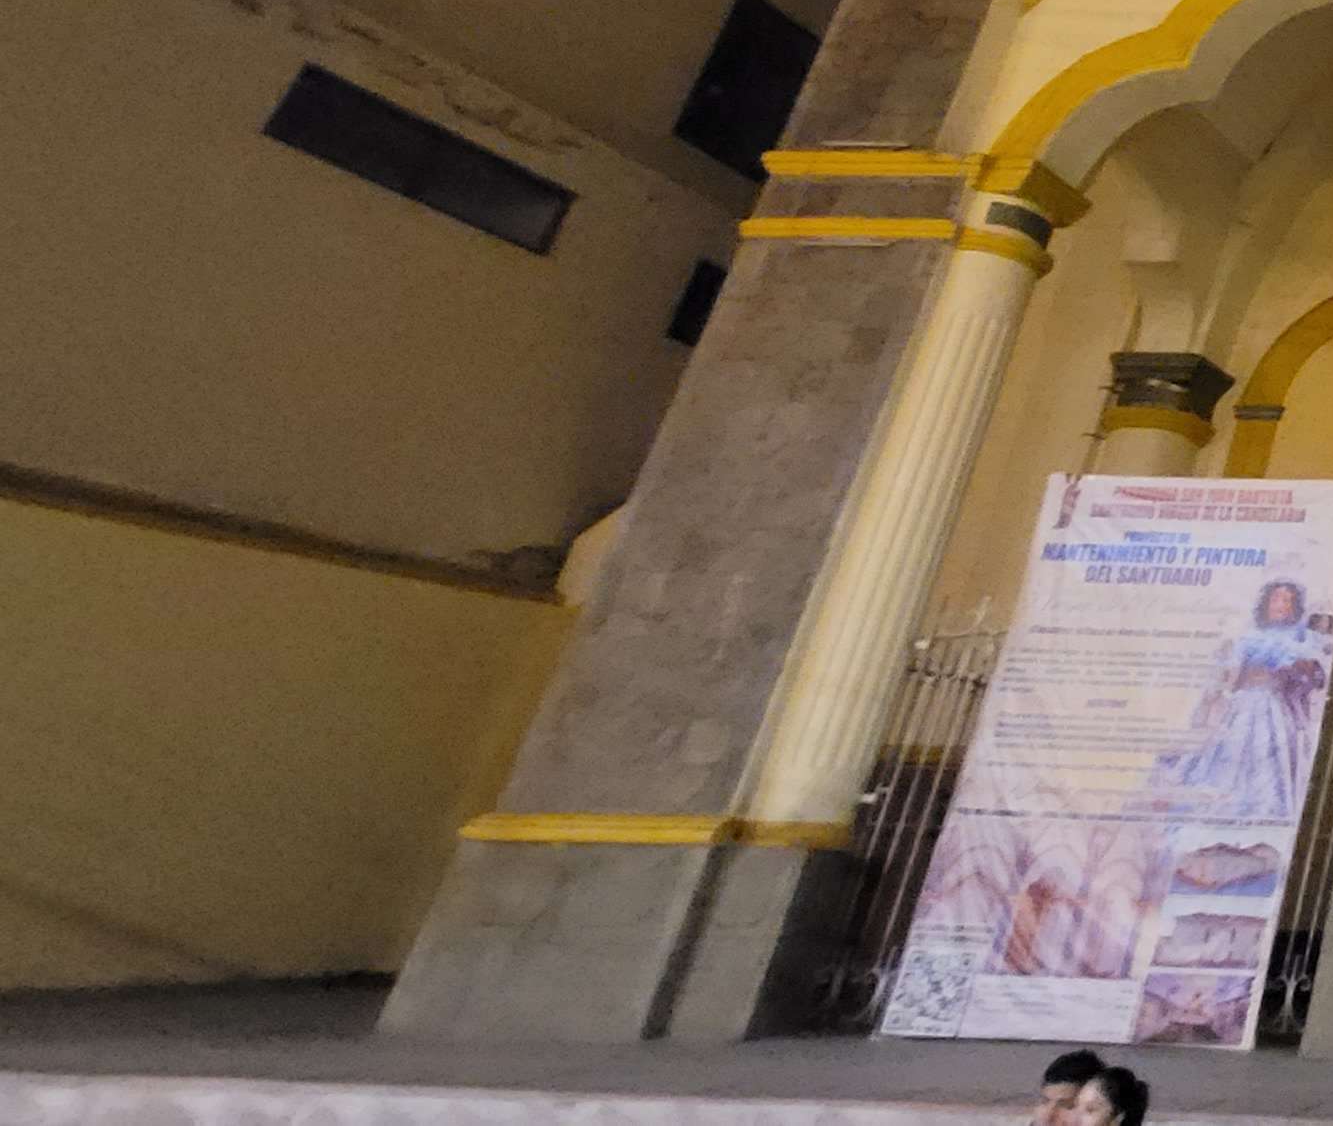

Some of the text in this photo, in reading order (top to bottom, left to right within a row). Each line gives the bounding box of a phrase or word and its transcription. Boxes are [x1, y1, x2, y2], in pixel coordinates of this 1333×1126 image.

[1041, 543, 1267, 567] MANTENIMIENTO Y PINTURA
[1085, 566, 1213, 587] DEL SANTUARIO
